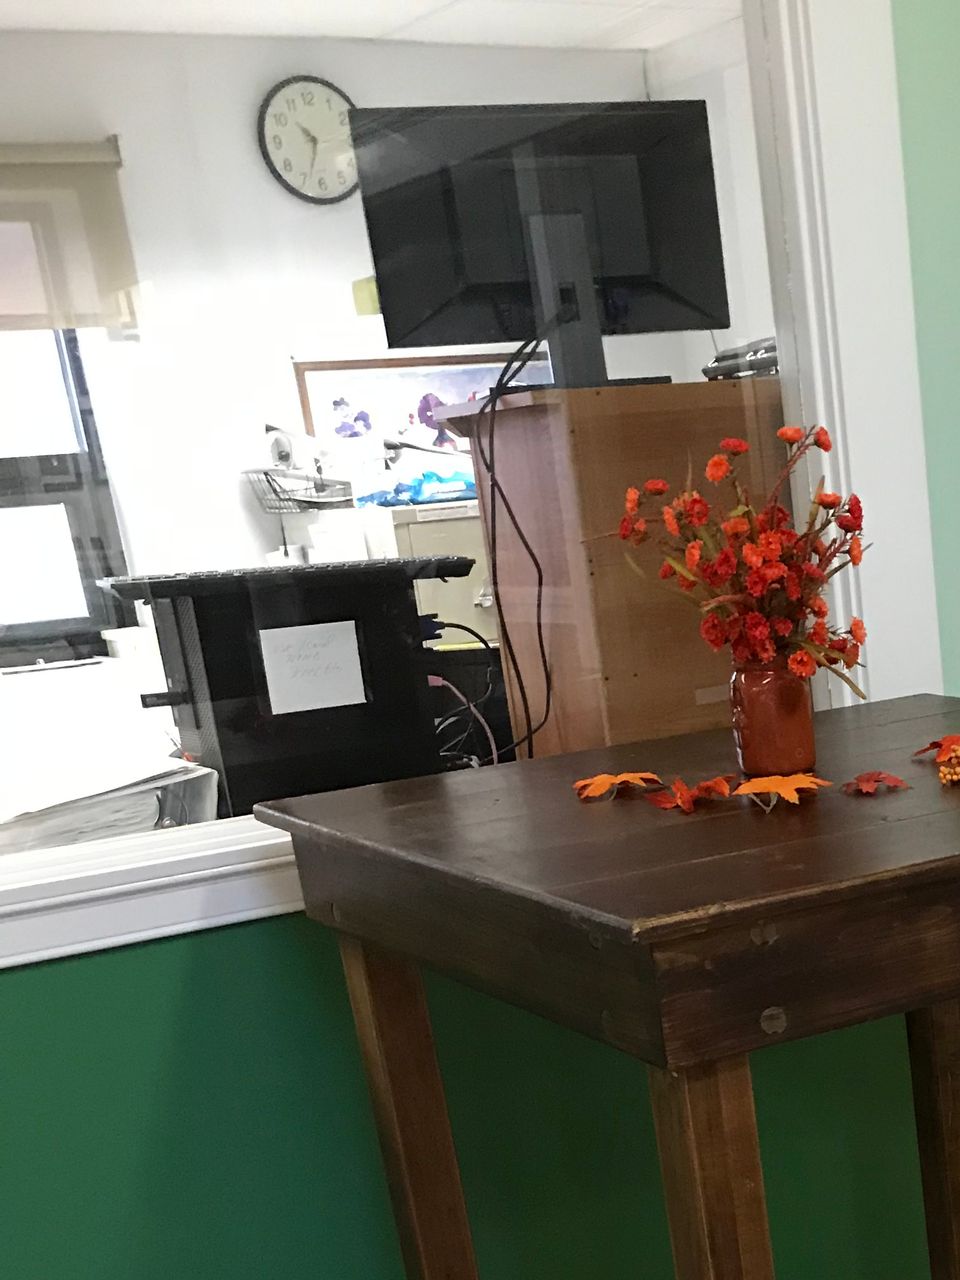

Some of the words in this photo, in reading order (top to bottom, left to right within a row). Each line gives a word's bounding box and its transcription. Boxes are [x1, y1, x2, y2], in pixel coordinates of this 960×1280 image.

[286, 98, 297, 112] 11
[300, 92, 314, 106] 12
[326, 98, 332, 111] 1
[273, 112, 288, 127] 10
[338, 112, 349, 126] 2
[272, 134, 282, 150] 9
[283, 158, 293, 172] 8
[299, 173, 308, 189] 7
[318, 177, 328, 191] 6
[337, 171, 346, 185] 5
